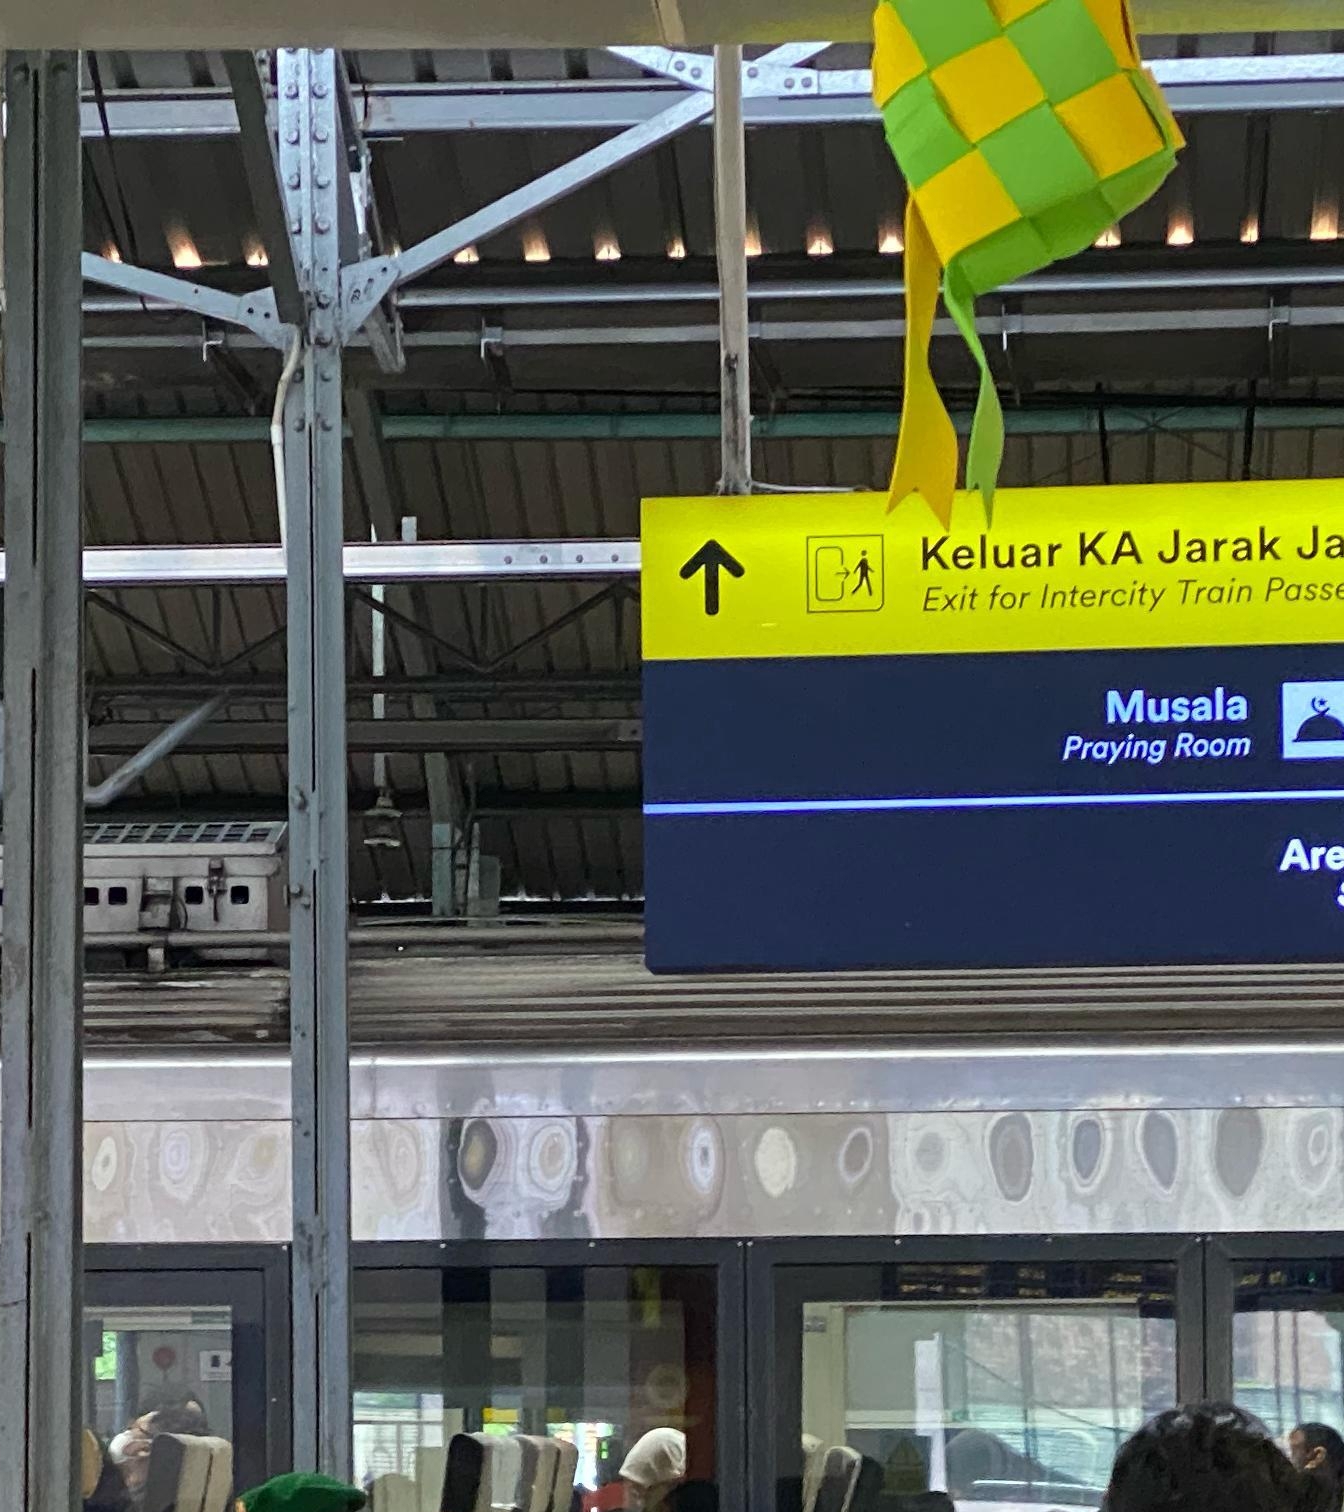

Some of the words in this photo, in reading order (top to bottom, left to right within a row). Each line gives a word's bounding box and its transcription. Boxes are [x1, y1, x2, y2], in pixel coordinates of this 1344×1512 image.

[922, 533, 1062, 571] Keluar
[1080, 531, 1143, 566] KA
[1158, 526, 1281, 564] Jarak
[923, 584, 979, 611] Exit
[988, 584, 1031, 611] for
[1041, 581, 1166, 612] Intercity
[1178, 579, 1253, 605] Train
[1107, 687, 1248, 724] Musala
[1063, 733, 1168, 764] Praying
[1174, 733, 1251, 758] Room
